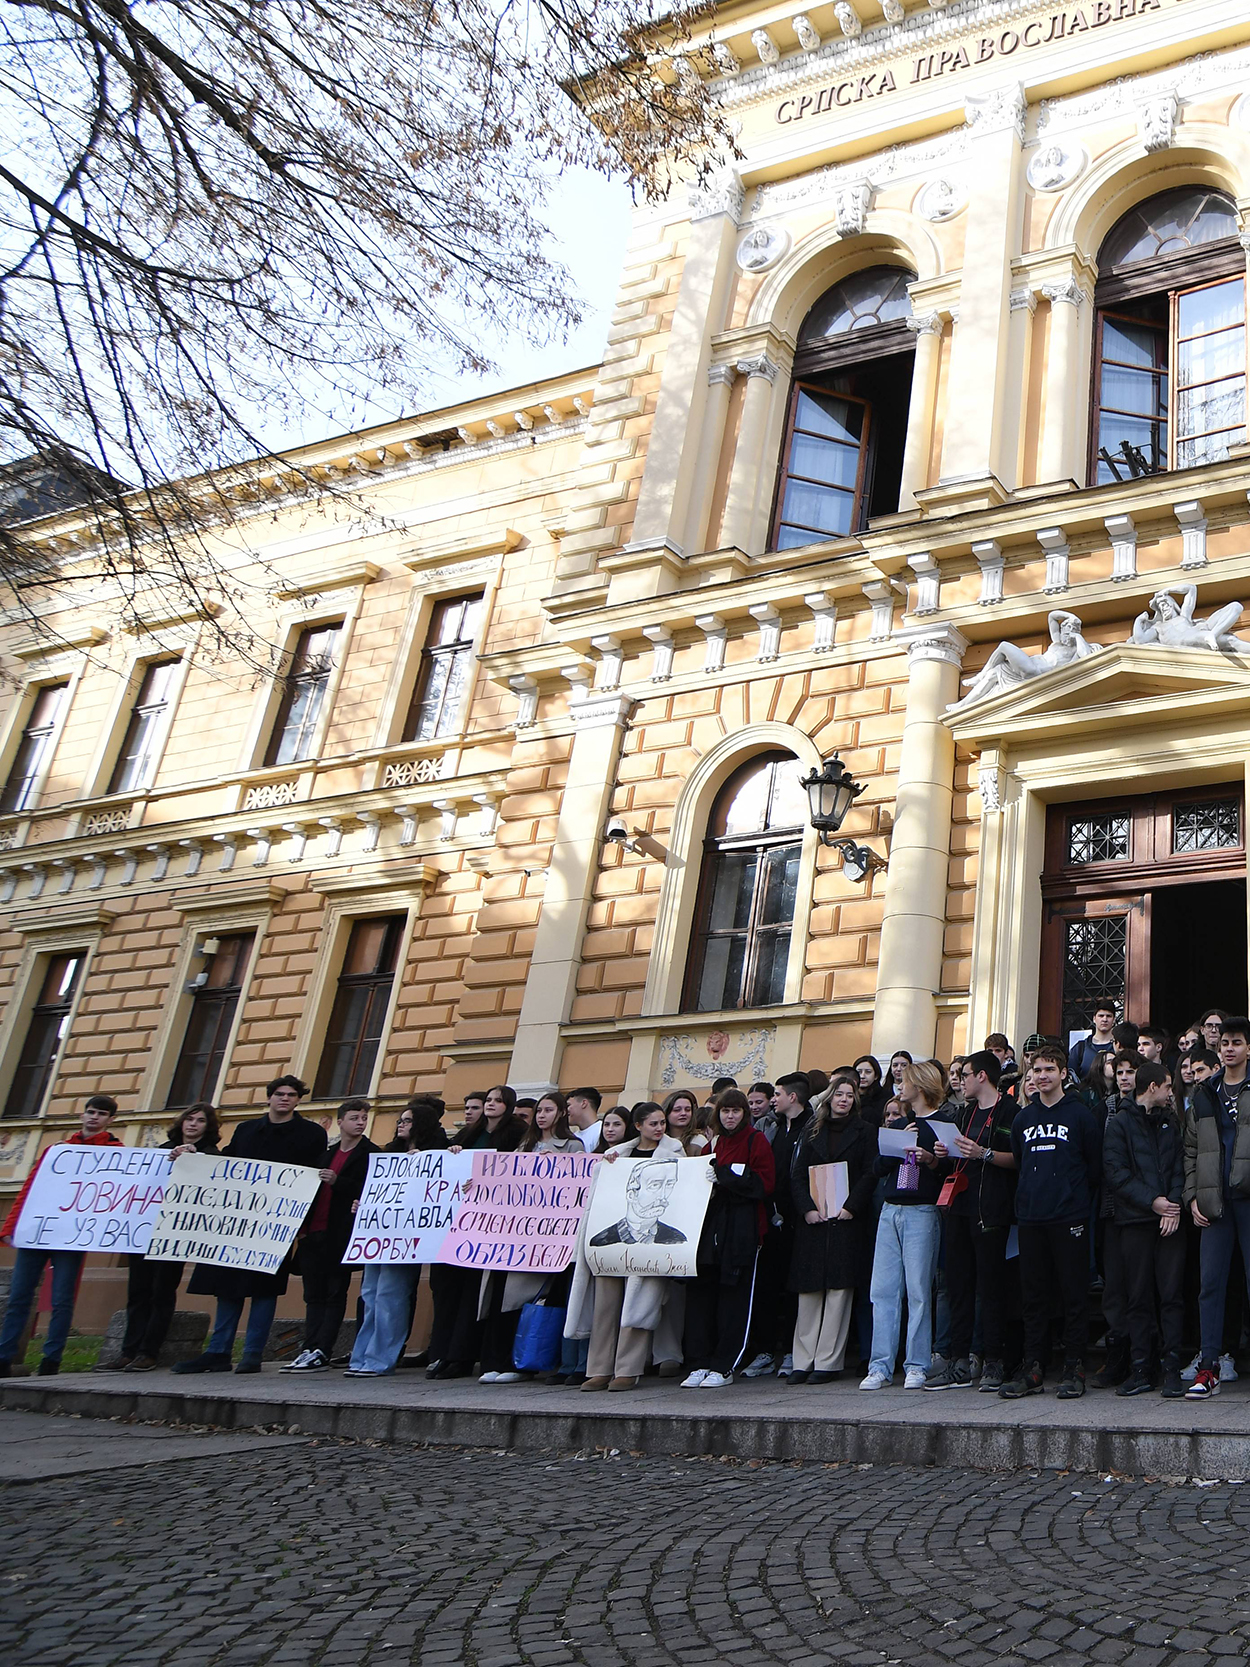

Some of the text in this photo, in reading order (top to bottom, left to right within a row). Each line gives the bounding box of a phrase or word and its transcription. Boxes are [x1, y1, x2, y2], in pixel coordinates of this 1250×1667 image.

[774, 68, 897, 124] СРПСКА
[1023, 1123, 1070, 1143] YALE
[210, 1159, 304, 1188] ДЕЦА СУ
[373, 1153, 443, 1178] БЛОКАДА
[481, 1154, 510, 1177] ИЗ
[58, 1181, 164, 1215] ЈОВИНА
[164, 1183, 267, 1214] ОГЛЕДАЛО
[364, 1179, 464, 1204] НИЈЕ КРА
[464, 1184, 490, 1205] ДО
[26, 1216, 152, 1248] ЈЕ УЗ ВАС
[156, 1211, 299, 1244] У ЊИХОВИМ ОЧИМ
[515, 1215, 537, 1236] СЕ
[537, 1217, 580, 1236] СВЕТЛ
[146, 1238, 285, 1269] ВИДИШ БУДУЋНО
[347, 1237, 421, 1261] БОРБУ!
[456, 1239, 527, 1267] ОБРАЗ
